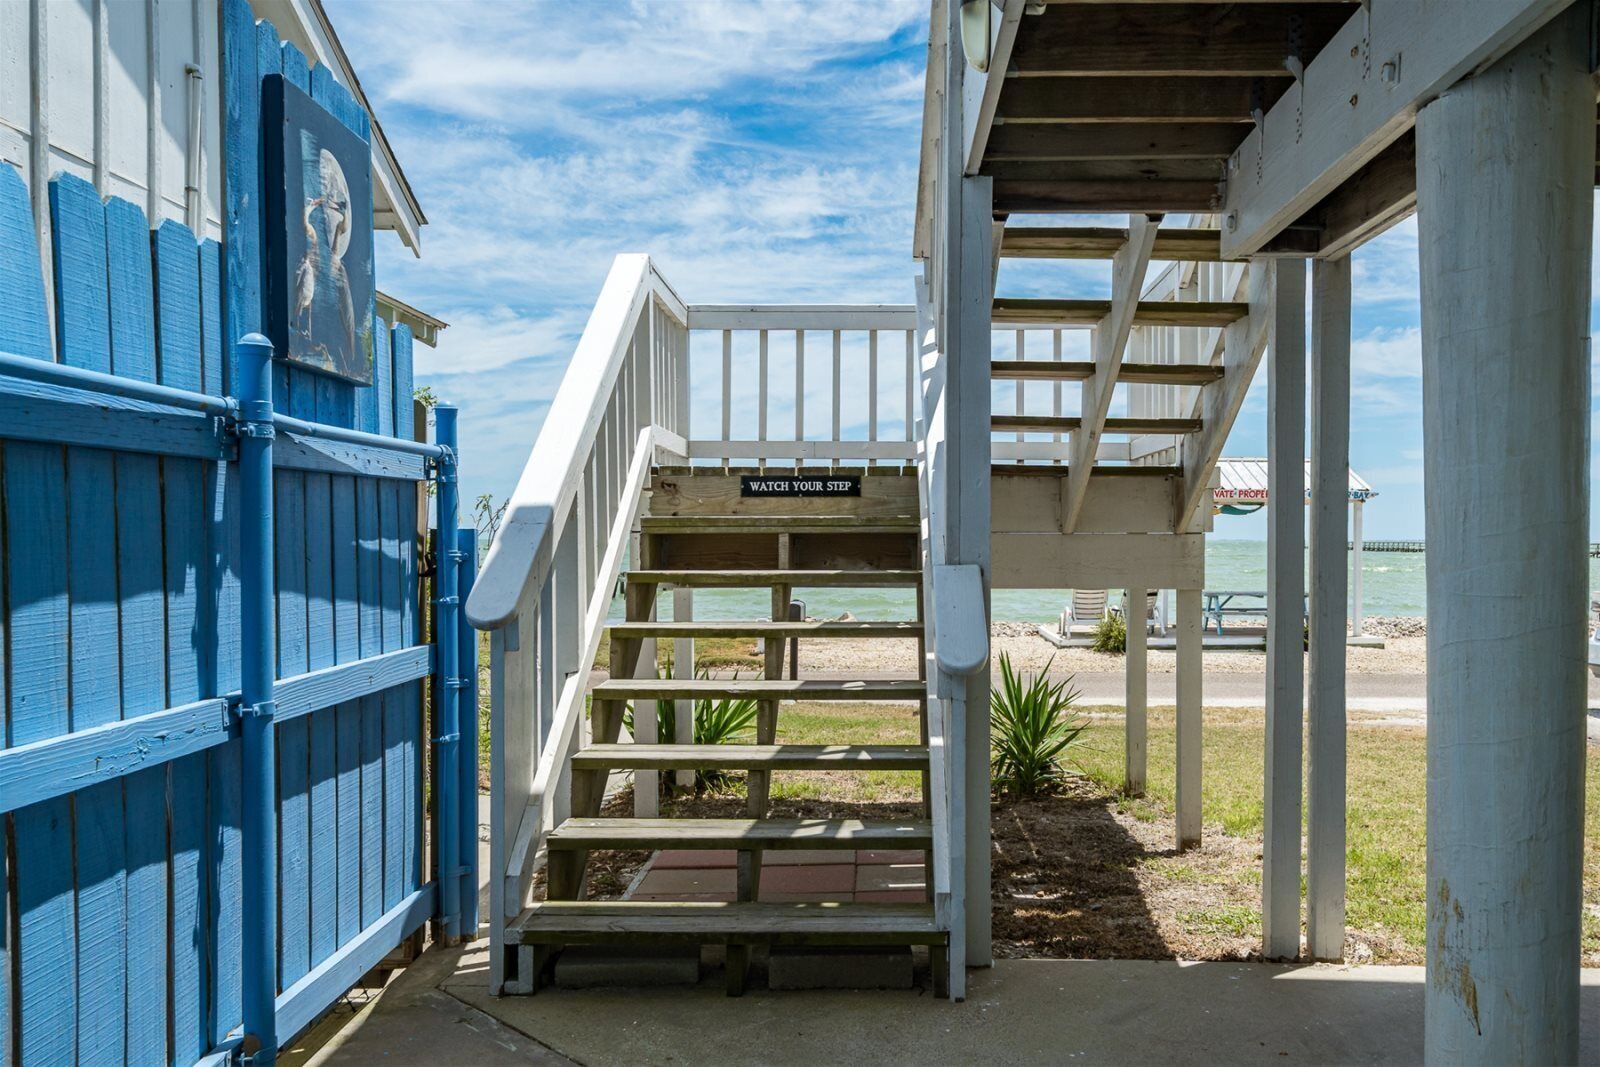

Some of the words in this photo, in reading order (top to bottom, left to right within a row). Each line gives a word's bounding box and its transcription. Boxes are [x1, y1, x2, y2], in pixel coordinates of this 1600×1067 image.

[749, 481, 789, 491] WATCH
[792, 481, 823, 491] YOUR
[827, 481, 852, 491] STEP
